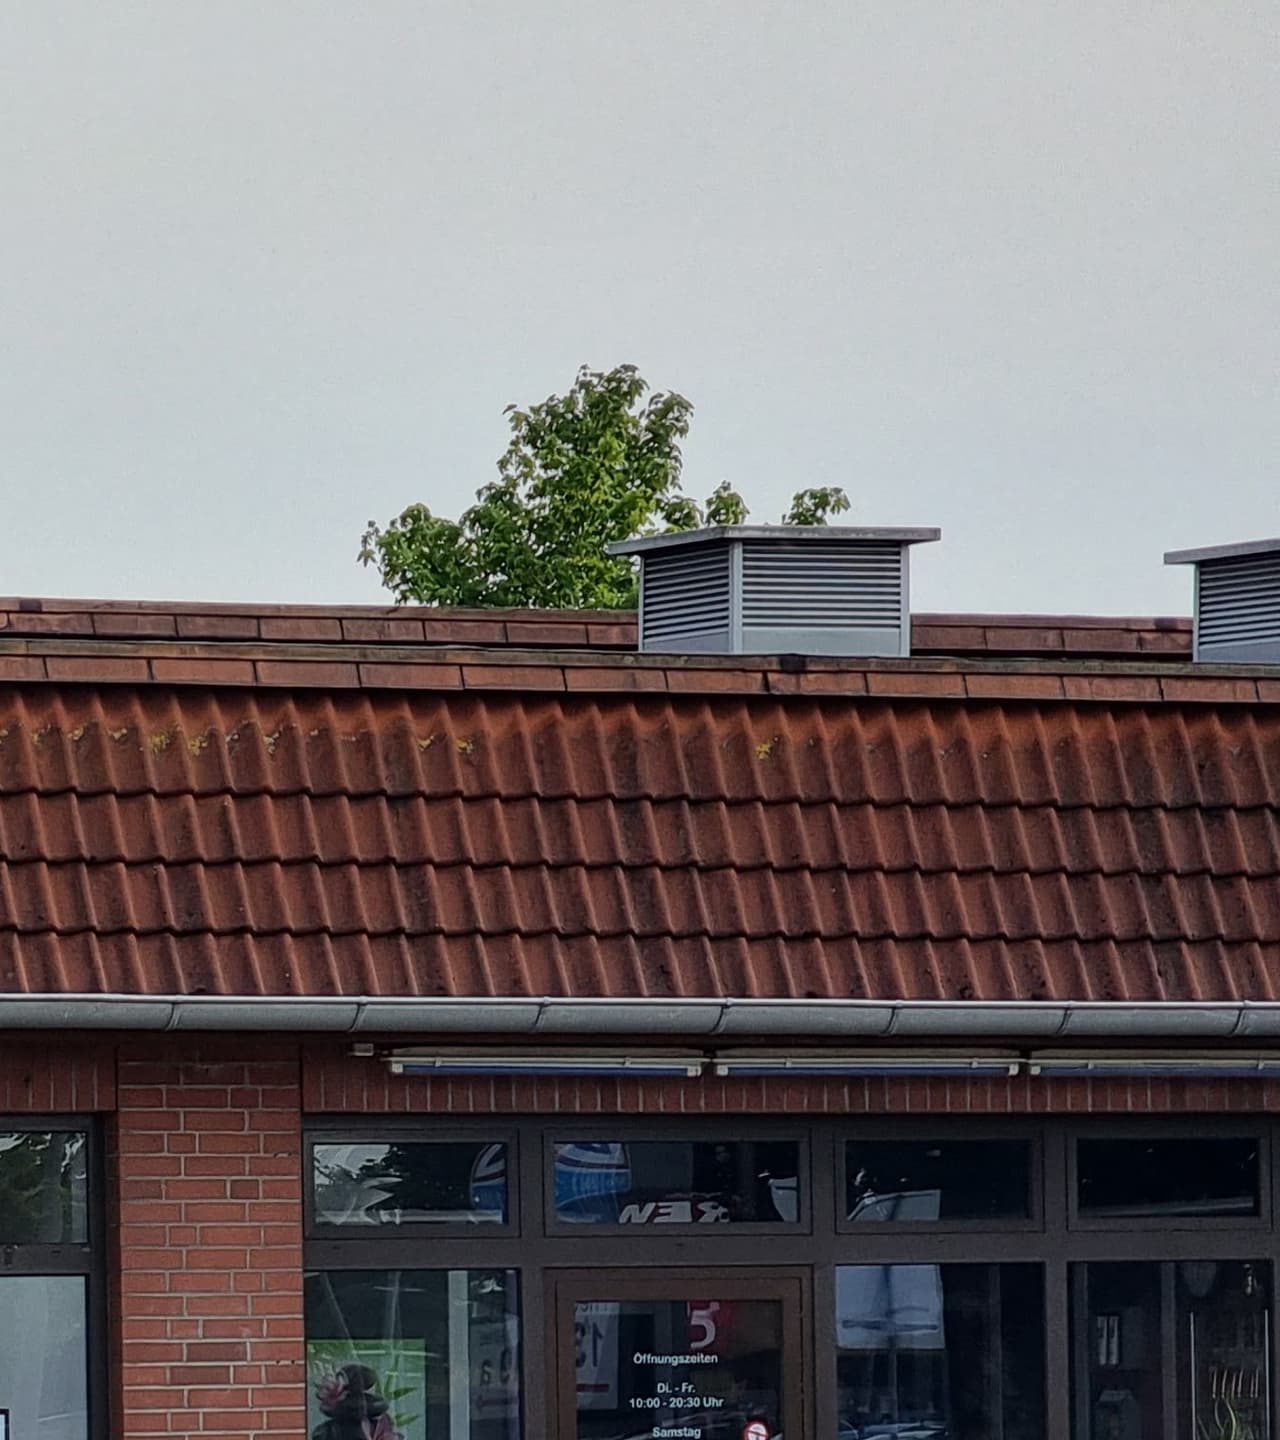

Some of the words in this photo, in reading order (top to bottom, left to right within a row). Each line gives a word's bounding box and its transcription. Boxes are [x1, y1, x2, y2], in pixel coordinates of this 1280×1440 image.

[633, 1352, 718, 1366] Öffnungszeiten
[681, 1383, 696, 1393] Fr.
[630, 1398, 660, 1408] 10:00
[669, 1397, 700, 1408] 20:30
[703, 1396, 724, 1408] Uhr
[652, 1426, 701, 1439] Samstag
